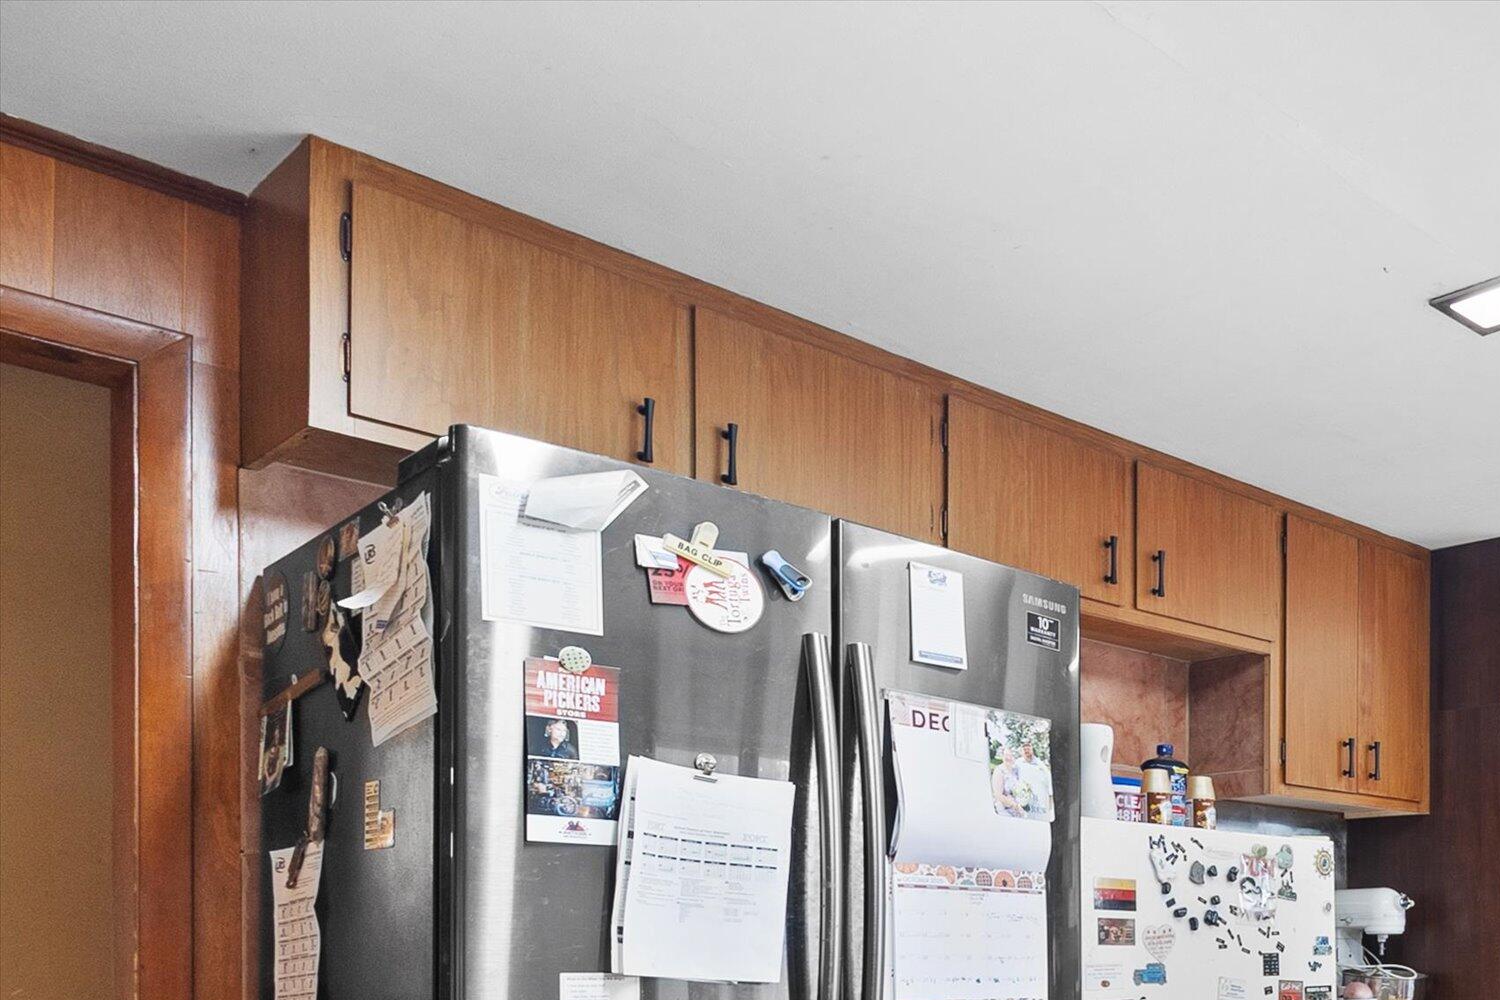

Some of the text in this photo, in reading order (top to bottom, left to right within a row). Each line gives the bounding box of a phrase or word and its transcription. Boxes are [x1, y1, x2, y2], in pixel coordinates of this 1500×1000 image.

[677, 541, 723, 567] BAG CLIP
[1022, 593, 1067, 614] SAMSUNG
[1037, 616, 1050, 630] 10
[536, 670, 607, 696] AMERICAN
[543, 689, 601, 713] PICKERS
[556, 708, 587, 718] STORE
